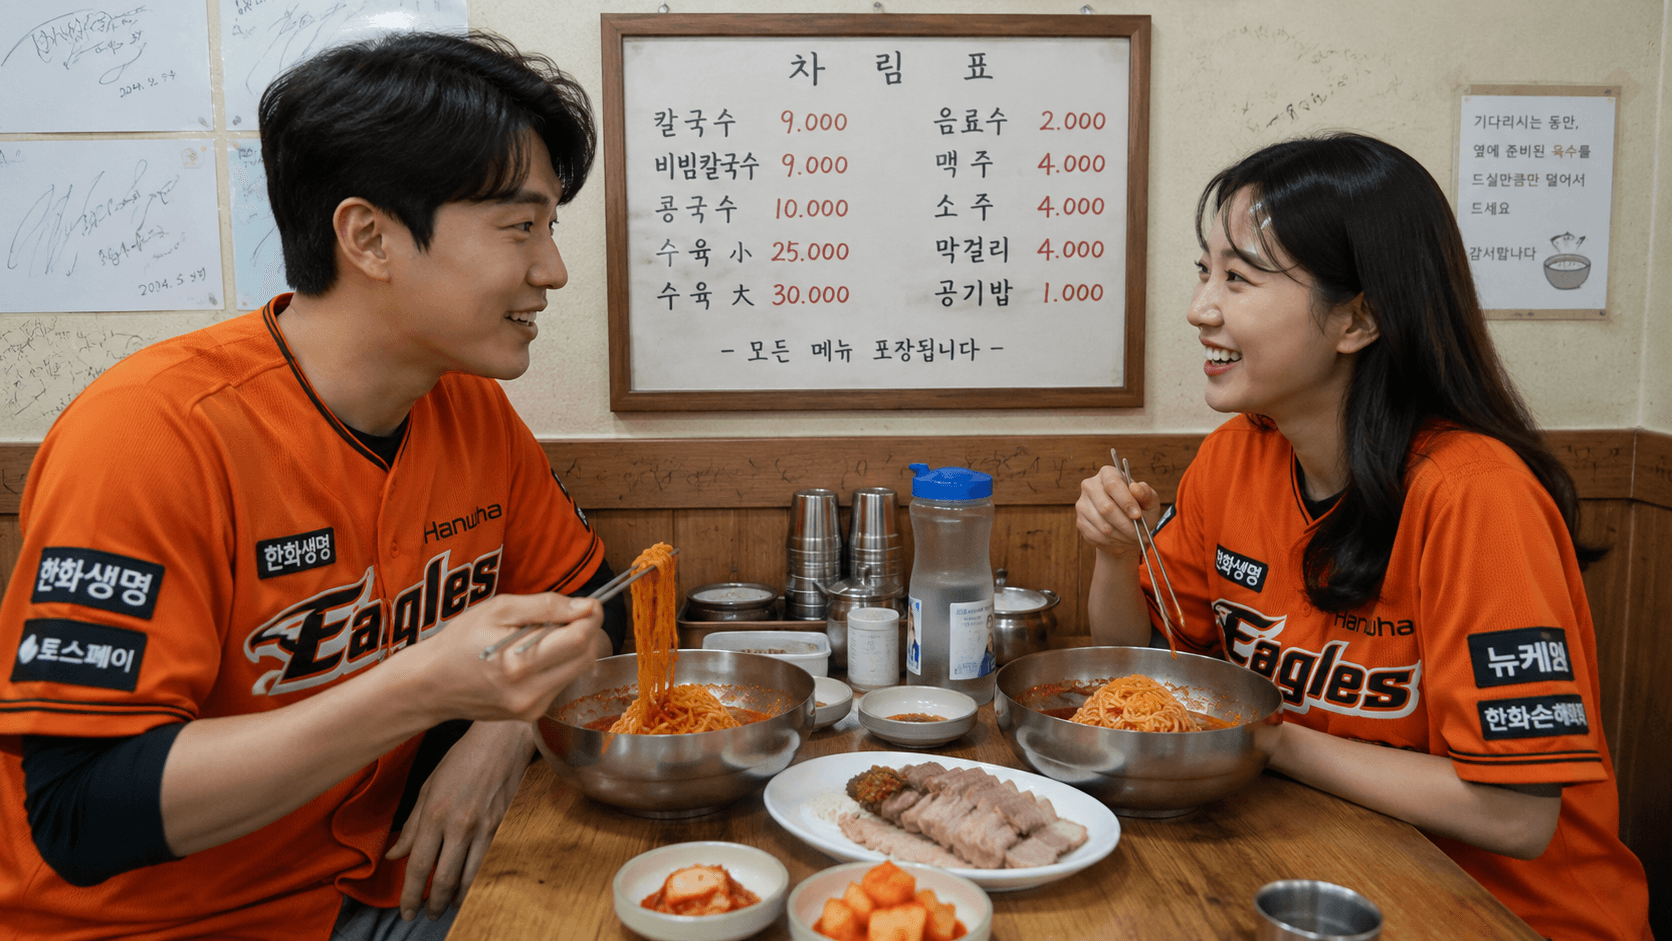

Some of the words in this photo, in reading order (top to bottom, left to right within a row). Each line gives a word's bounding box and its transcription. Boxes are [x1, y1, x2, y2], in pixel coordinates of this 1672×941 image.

[788, 50, 994, 86] 차림표
[653, 107, 737, 138] 칼국수
[780, 109, 848, 134] 9.000
[933, 106, 1008, 136] 음료수
[1039, 109, 1107, 132] 2.000
[1474, 114, 1543, 131] 기다리시는
[654, 151, 760, 181] 비빔칼국수
[781, 152, 849, 177] 9.000
[935, 149, 994, 179] 맥주
[1037, 151, 1106, 176] 4.000
[1473, 143, 1500, 159] 옆에
[1505, 143, 1545, 159] 준비된
[1551, 143, 1592, 159] 육수를
[1472, 172, 1540, 188] 드실만큼만
[1545, 172, 1586, 188] 덜어서
[654, 194, 738, 224] 콩국수
[775, 197, 849, 220] 10.000
[934, 192, 994, 222] 소주
[1037, 194, 1105, 219] 4.000
[1471, 201, 1511, 216] 드세요
[656, 238, 712, 268] 수육
[729, 240, 753, 264] 小
[770, 239, 850, 263] 25.000
[935, 235, 1009, 265] 막걸리
[1037, 237, 1105, 262] 4.000
[656, 281, 713, 311] 수육
[731, 283, 755, 307] 大
[771, 283, 850, 307] 30.000
[934, 278, 1014, 308] 공기밥
[1043, 281, 1104, 304] 1.000
[747, 339, 790, 364] 모든
[810, 338, 854, 364] 메뉴
[872, 337, 981, 363] 포장됩니다
[424, 503, 503, 544] Hanwha
[264, 533, 332, 572] 한화생명
[37, 557, 153, 606] 한화생명
[244, 543, 504, 697] Eagles
[36, 637, 135, 673] 토스페이
[1211, 598, 1421, 719] Eagles
